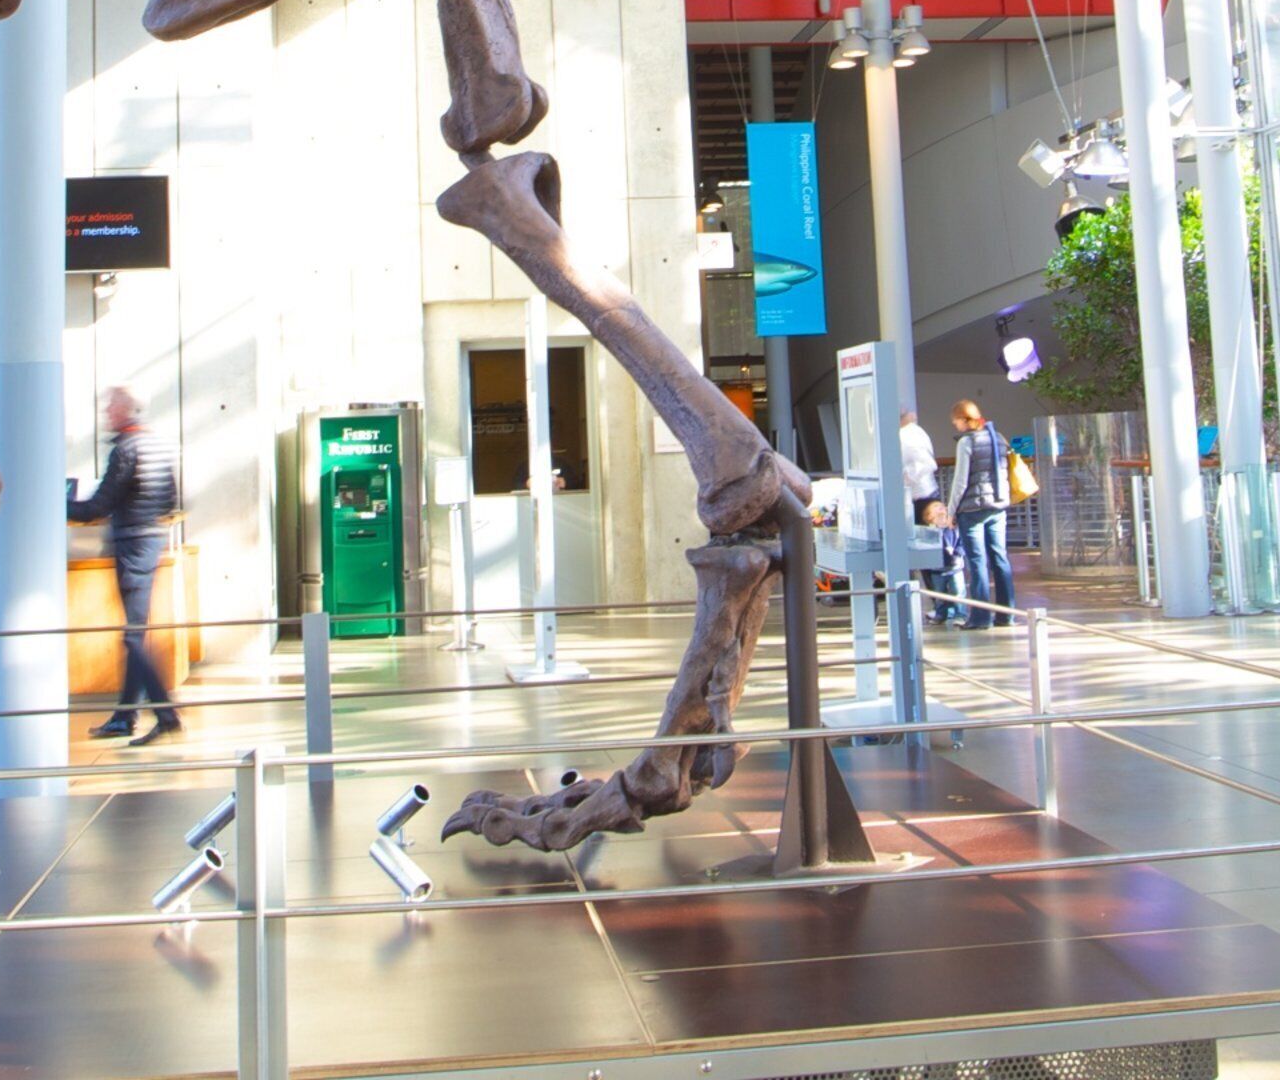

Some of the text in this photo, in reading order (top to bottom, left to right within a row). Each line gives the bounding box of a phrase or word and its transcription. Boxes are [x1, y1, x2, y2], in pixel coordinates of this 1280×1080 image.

[799, 133, 816, 240] Philippine Coral Reef
[87, 211, 134, 222] admission
[81, 225, 141, 237] membership.
